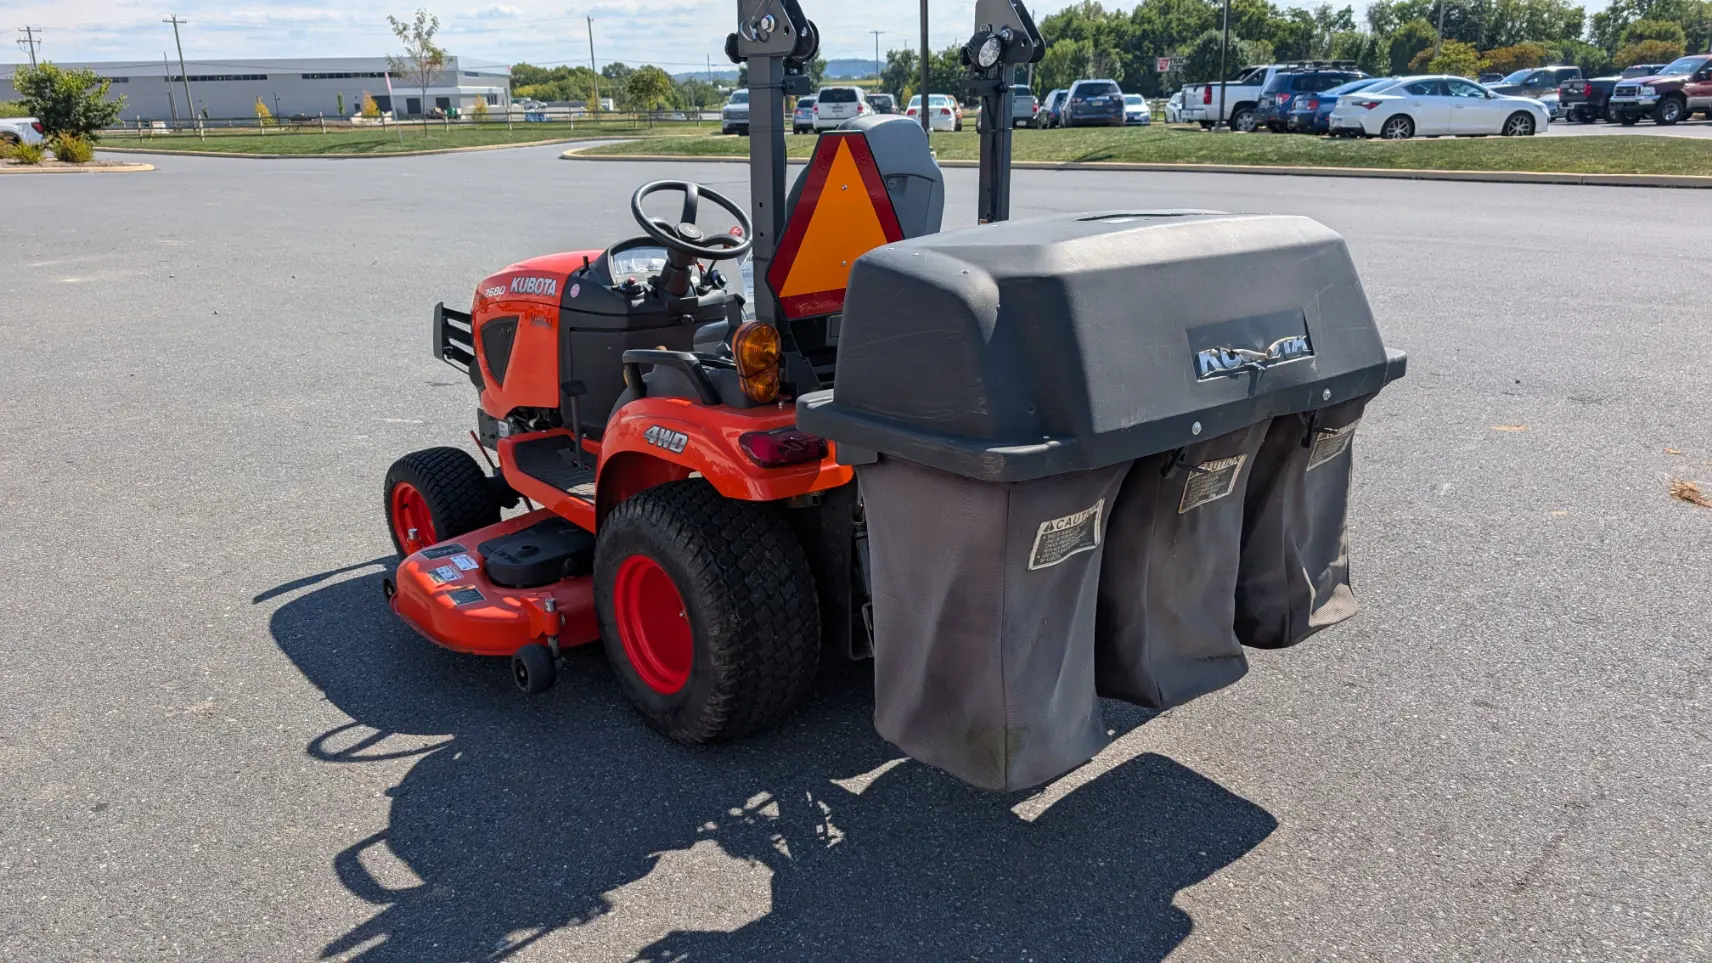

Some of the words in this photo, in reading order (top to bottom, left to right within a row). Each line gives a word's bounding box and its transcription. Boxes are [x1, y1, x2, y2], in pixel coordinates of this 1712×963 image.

[510, 277, 556, 297] KUBOTA
[643, 424, 689, 454] 4WD
[1201, 456, 1241, 471] AUTION
